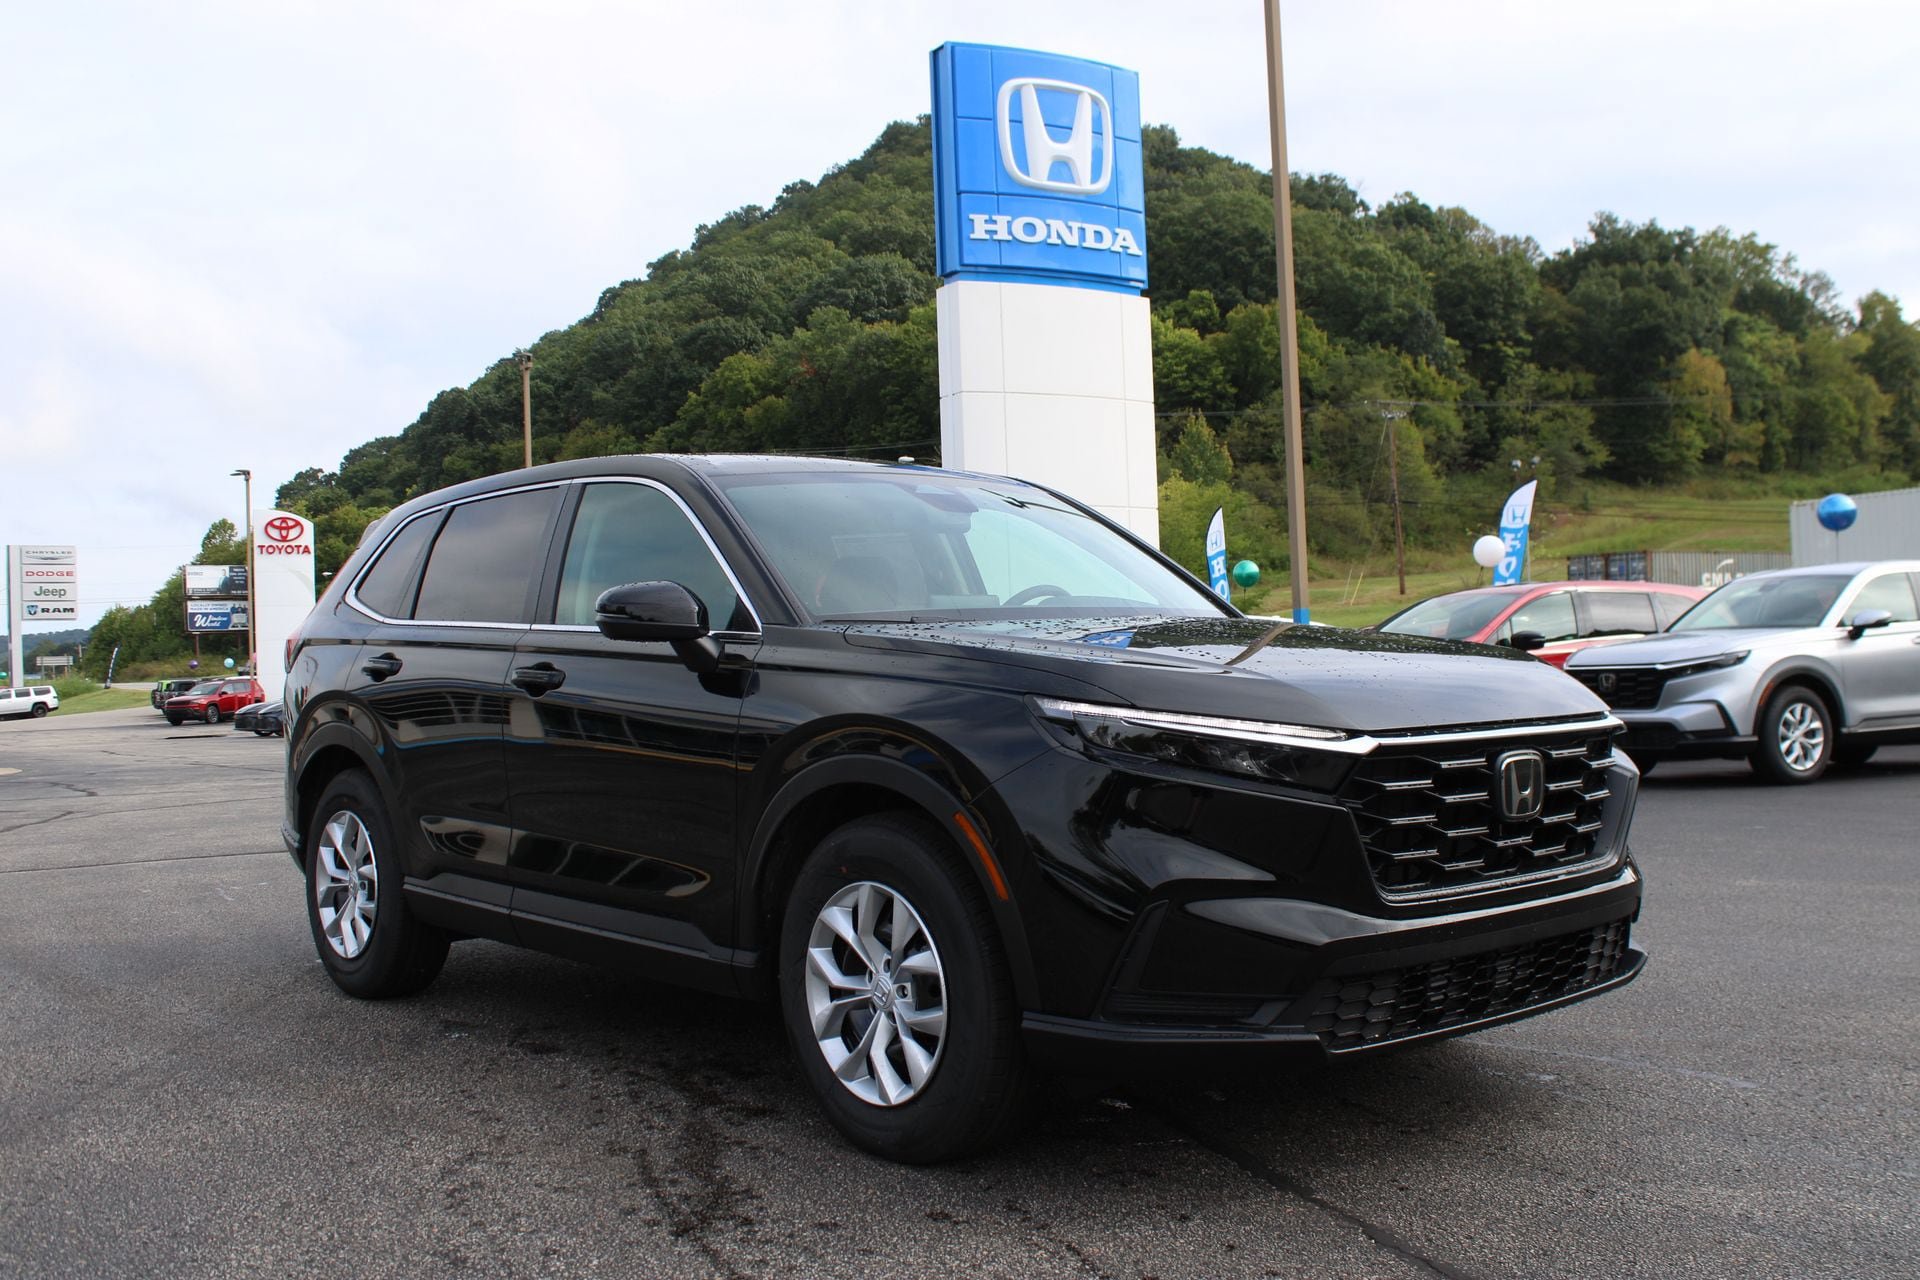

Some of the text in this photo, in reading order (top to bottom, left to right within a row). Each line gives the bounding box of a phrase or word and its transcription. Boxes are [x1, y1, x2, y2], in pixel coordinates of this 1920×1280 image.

[968, 214, 1143, 256] HONDA
[257, 544, 311, 555] TOYOTA
[34, 586, 67, 598] Jeep
